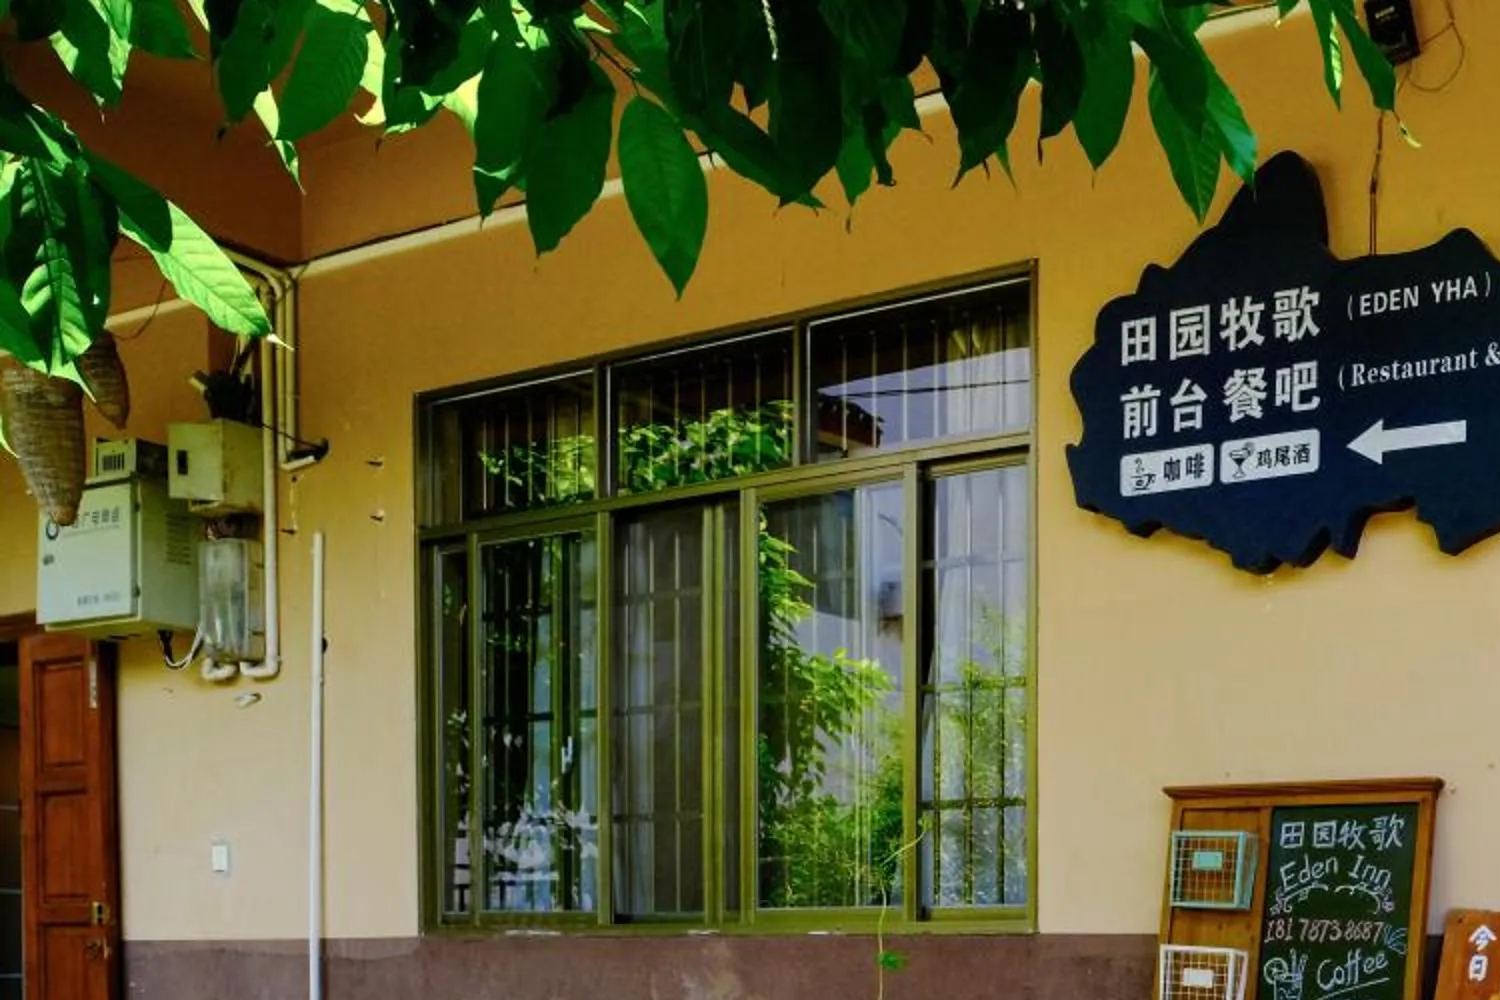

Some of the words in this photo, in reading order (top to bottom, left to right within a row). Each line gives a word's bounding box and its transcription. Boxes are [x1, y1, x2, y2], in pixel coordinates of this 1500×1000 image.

[1347, 285, 1420, 321] (EDEN
[1431, 271, 1492, 304] YHA)
[1120, 285, 1321, 367] 田园牧歌
[1338, 347, 1479, 391] (Restaurant
[1163, 452, 1206, 483] 咖啡
[1255, 442, 1312, 470] 鸡尾酒
[1279, 812, 1405, 851] 田园牧歌
[1279, 852, 1339, 893] Eden
[1347, 854, 1392, 891] Inn
[1316, 948, 1389, 991] Coffee
